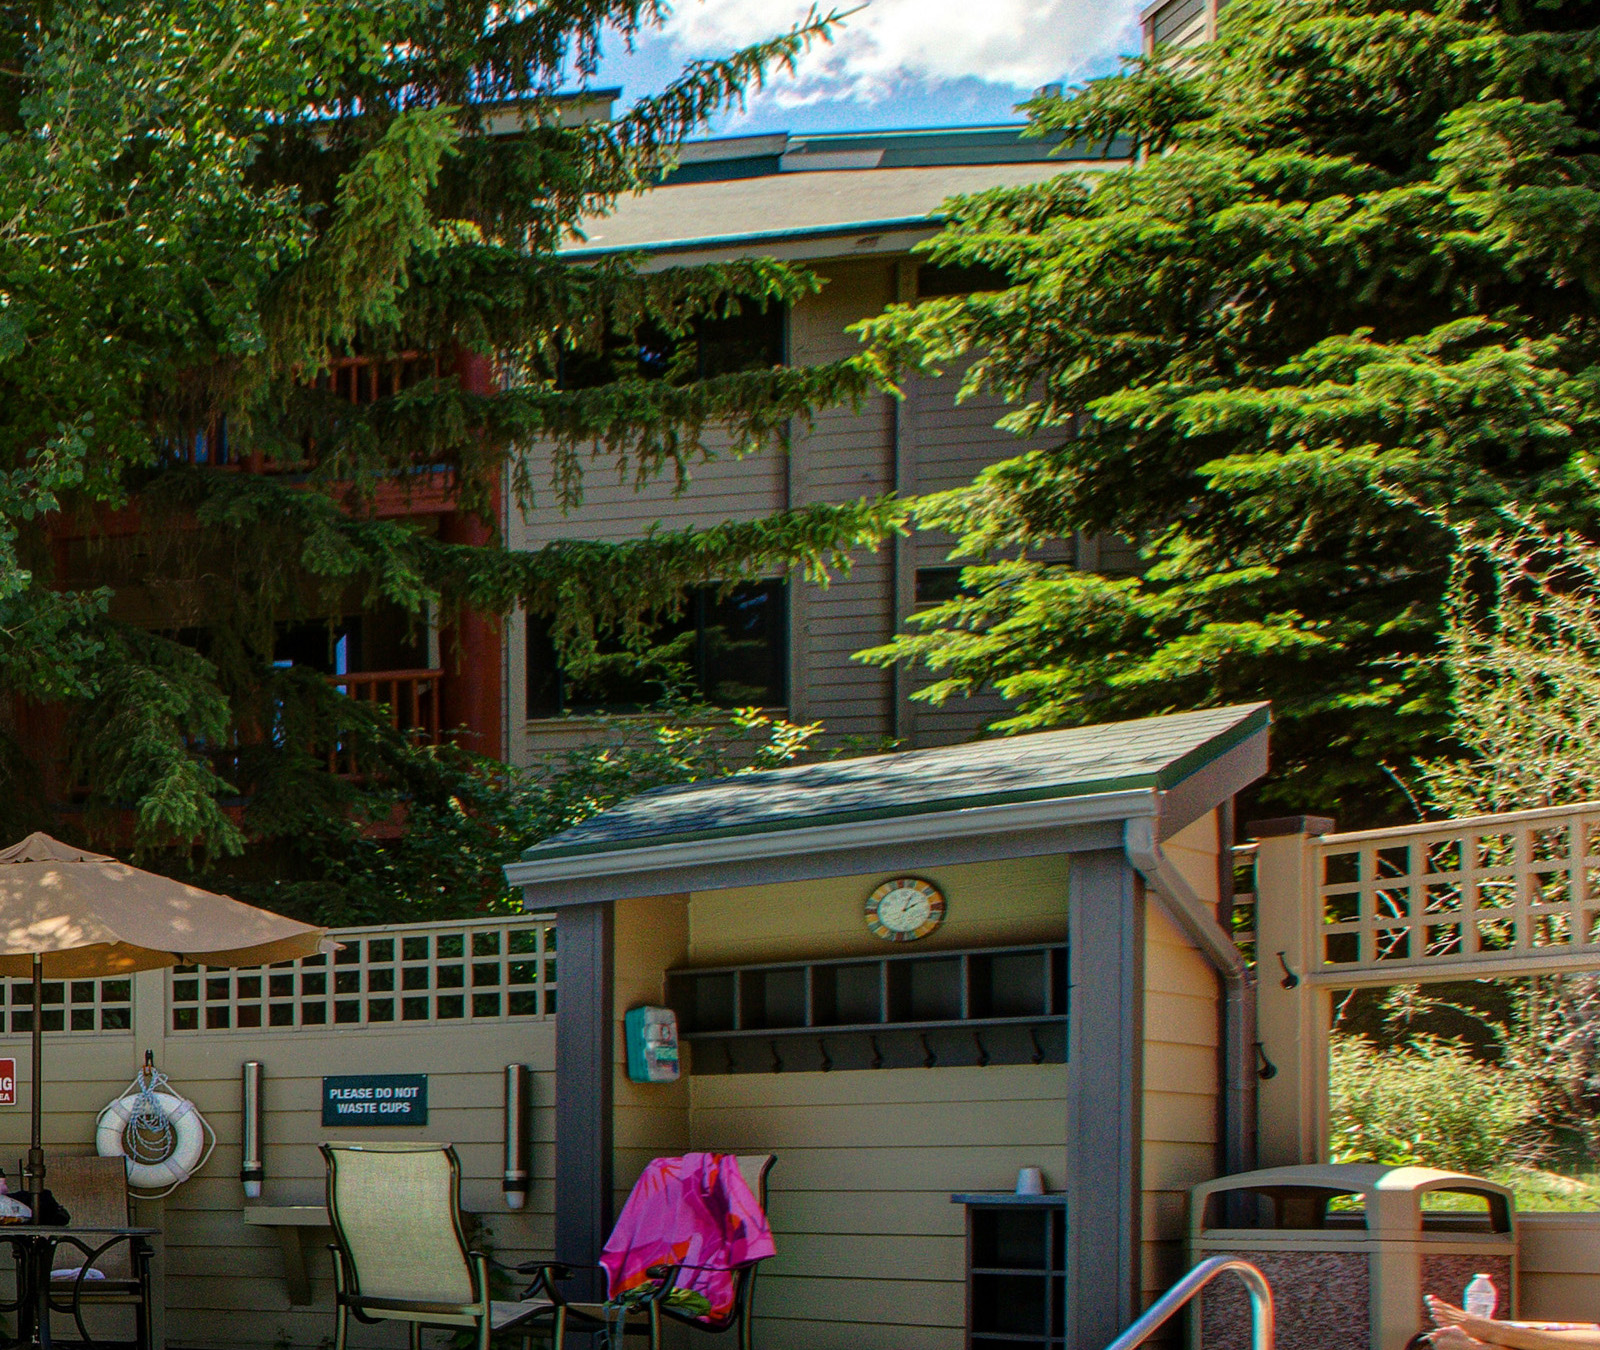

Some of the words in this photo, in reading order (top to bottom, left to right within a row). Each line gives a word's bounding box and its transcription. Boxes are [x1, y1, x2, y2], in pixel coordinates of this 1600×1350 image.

[330, 1088, 373, 1099] PLEASE
[376, 1088, 392, 1098] DO
[395, 1087, 419, 1098] NOT
[337, 1103, 377, 1113] WASTE
[380, 1102, 411, 1113] CUPS
